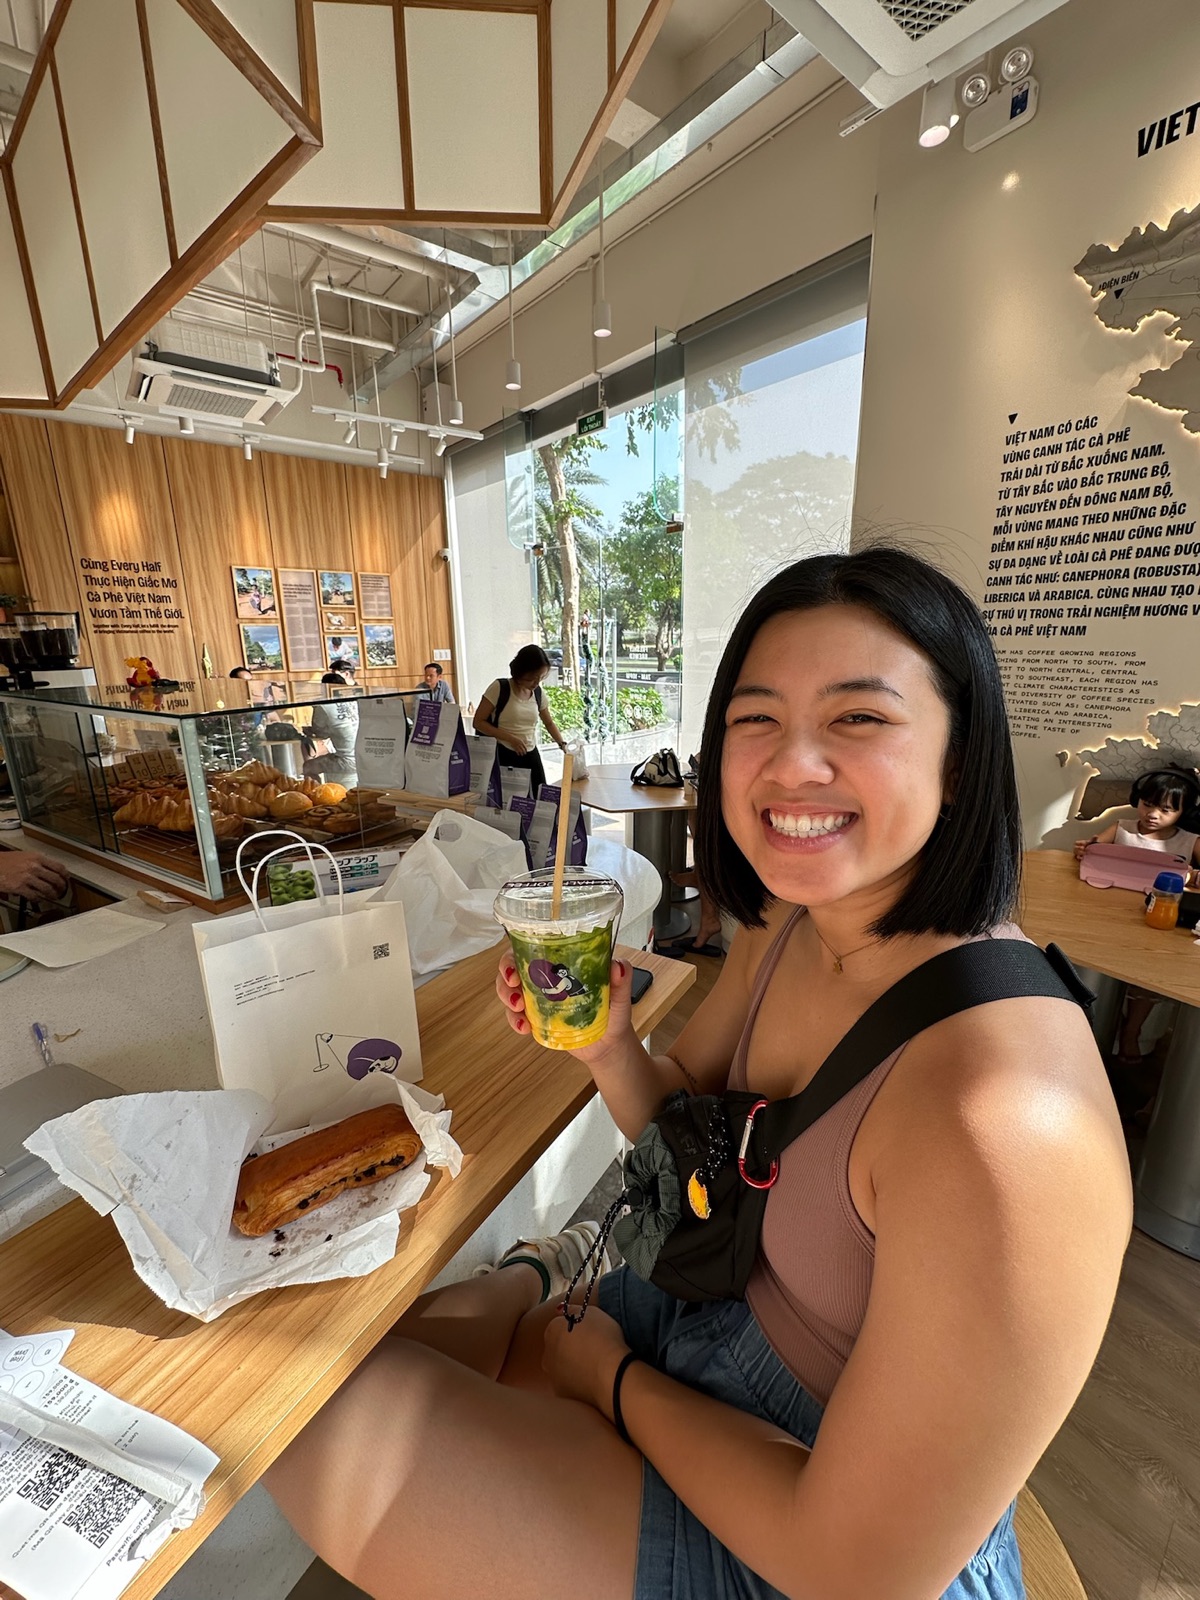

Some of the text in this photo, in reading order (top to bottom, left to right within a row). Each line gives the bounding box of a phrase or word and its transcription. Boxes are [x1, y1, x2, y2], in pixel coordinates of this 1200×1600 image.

[1005, 416, 1098, 446] VIỆT NAM CÓ CÁC
[1003, 427, 1131, 464] VÙNG CANH TÁC CÀ PHÊ
[1024, 464, 1043, 478] DÀI
[1045, 461, 1060, 475] TỪ
[1085, 449, 1128, 468] XUỐNG
[1130, 444, 1165, 460] NAM.
[998, 487, 1012, 500] TỪ
[1012, 485, 1031, 498] TÂY
[1057, 478, 1078, 491] VÀO
[1106, 467, 1148, 484] TRUNG
[995, 505, 1013, 518] TÂY
[1014, 499, 1057, 516] NGUYÊN
[1083, 492, 1117, 507] ĐÔNG
[1119, 487, 1151, 502] NAM
[1015, 520, 1043, 533] VÙNG
[1044, 516, 1079, 530] MANG
[1081, 512, 1110, 526] THEO
[1016, 537, 1035, 550] KHÍ
[1036, 536, 1058, 550] HẬU
[1059, 532, 1090, 546] KHÁC
[1091, 530, 1125, 543] NHAU
[1127, 525, 1163, 540] CŨNG
[1165, 521, 1196, 537] NHƯ
[1003, 559, 1016, 569] ĐA
[1018, 556, 1047, 570] DẠNG
[1064, 551, 1089, 564] LOÀI
[1091, 549, 1106, 562] CÀ
[1109, 546, 1133, 561] PHÊ
[1134, 546, 1171, 559] ĐANG
[1173, 542, 1200, 558] ĐƯỢ
[81, 558, 161, 573] Cùng Every Half
[84, 575, 178, 589] Thực Hiện Giấc Mơ
[986, 576, 1013, 587] CANH
[1014, 573, 1033, 585] TÁC
[1062, 568, 1130, 582] CANEPHORA
[87, 591, 172, 605] Cà Phê Việt Nam
[983, 592, 1025, 603] LIBERICA
[1028, 590, 1040, 602] VÀ
[1042, 589, 1093, 601] ARABICA.
[1096, 586, 1129, 599] CÙNG
[1131, 586, 1167, 598] NHAU
[1170, 584, 1195, 599] TẠO
[89, 608, 118, 619] Vươn
[119, 606, 142, 619] Tầm
[143, 607, 162, 619] Thế
[996, 608, 1015, 619] THÚ
[1017, 609, 1027, 621] VỊ
[1029, 608, 1064, 619] TRONG
[1093, 604, 1141, 620] NGHIỆM
[1142, 604, 1188, 616] HƯƠNG
[999, 625, 1012, 636] CÀ
[1014, 624, 1034, 636] PHÊ
[1036, 624, 1058, 638] VIỆT
[1059, 626, 1087, 636] NAM
[1056, 667, 1094, 675] CENTRAL,
[1100, 668, 1138, 676] CENTRAL
[1028, 675, 1073, 683] SOUTHEAST,
[1104, 677, 1137, 685] REGION
[1049, 684, 1124, 694] CHARACTERISTICS
[1021, 691, 1062, 699] DIVERSITY
[1080, 694, 1112, 702] COFFEE
[1116, 696, 1155, 705] SPECIES
[1014, 707, 1050, 715] LIBERICA
[1072, 711, 1112, 720] ARABICA.
[1084, 703, 1131, 712] CANEPHORA
[1043, 725, 1066, 733] TASTE
[1058, 718, 1112, 729] INTERESTING
